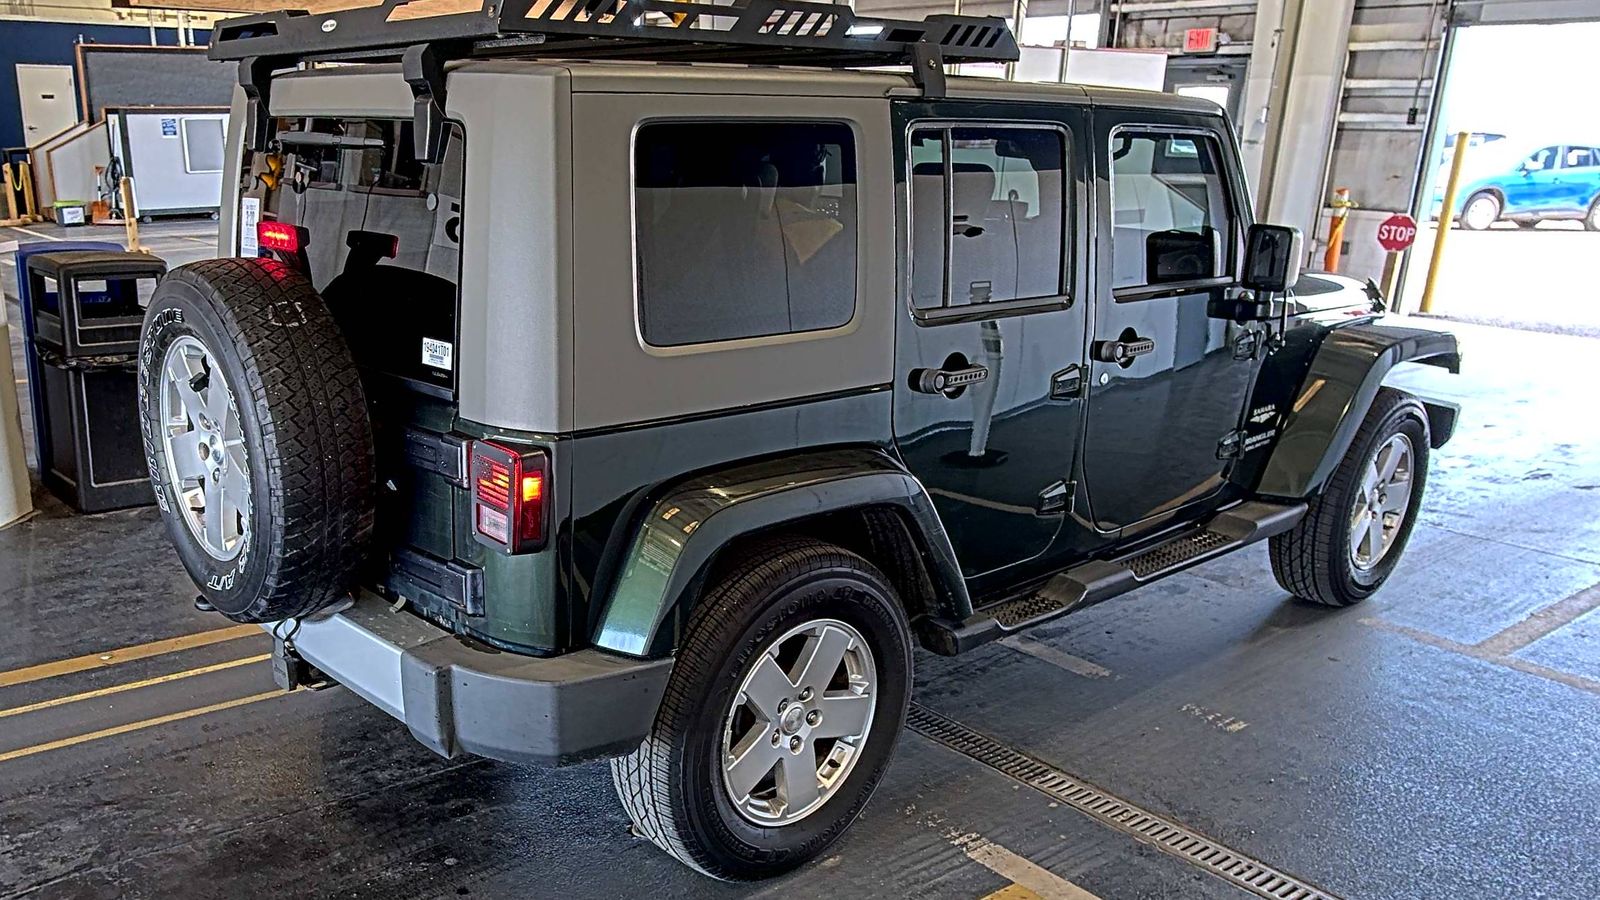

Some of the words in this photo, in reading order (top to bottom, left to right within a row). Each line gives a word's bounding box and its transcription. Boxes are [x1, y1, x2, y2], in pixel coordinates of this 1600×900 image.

[1188, 30, 1210, 49] EXIT
[1379, 224, 1416, 242] STOP
[1253, 403, 1275, 416] SAHARA
